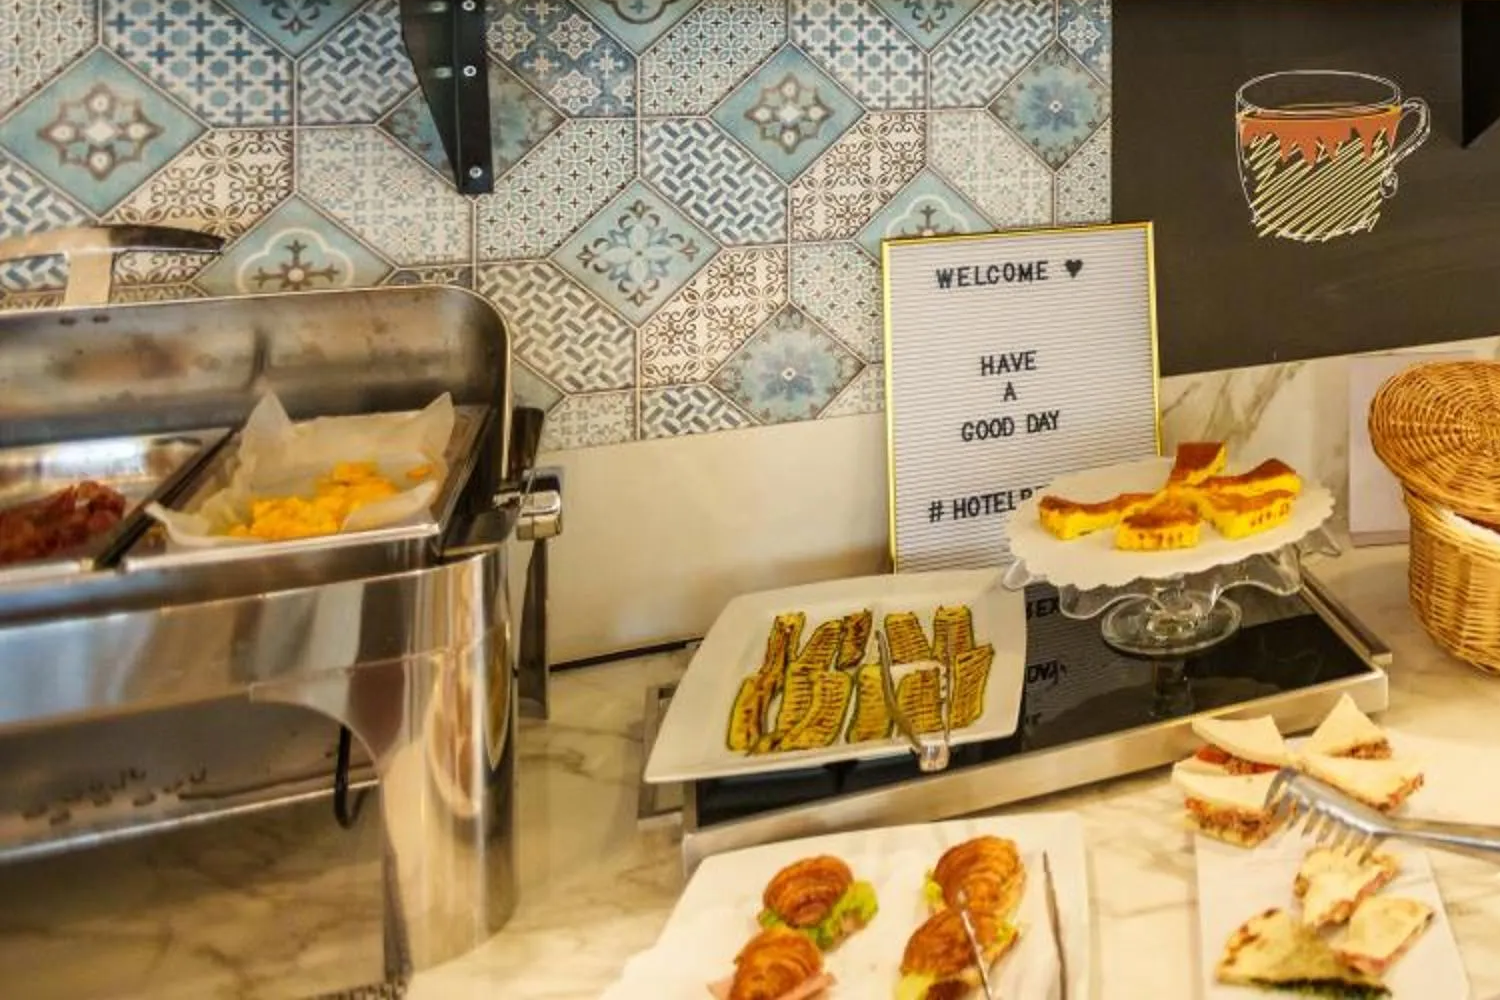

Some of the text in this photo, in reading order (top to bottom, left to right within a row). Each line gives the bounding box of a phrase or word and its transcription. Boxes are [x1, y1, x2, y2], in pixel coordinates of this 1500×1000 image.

[936, 260, 1049, 289] WELCOME
[980, 350, 1037, 376] HAVE
[1003, 381, 1018, 401] A
[961, 410, 1060, 442] GOOD DAY
